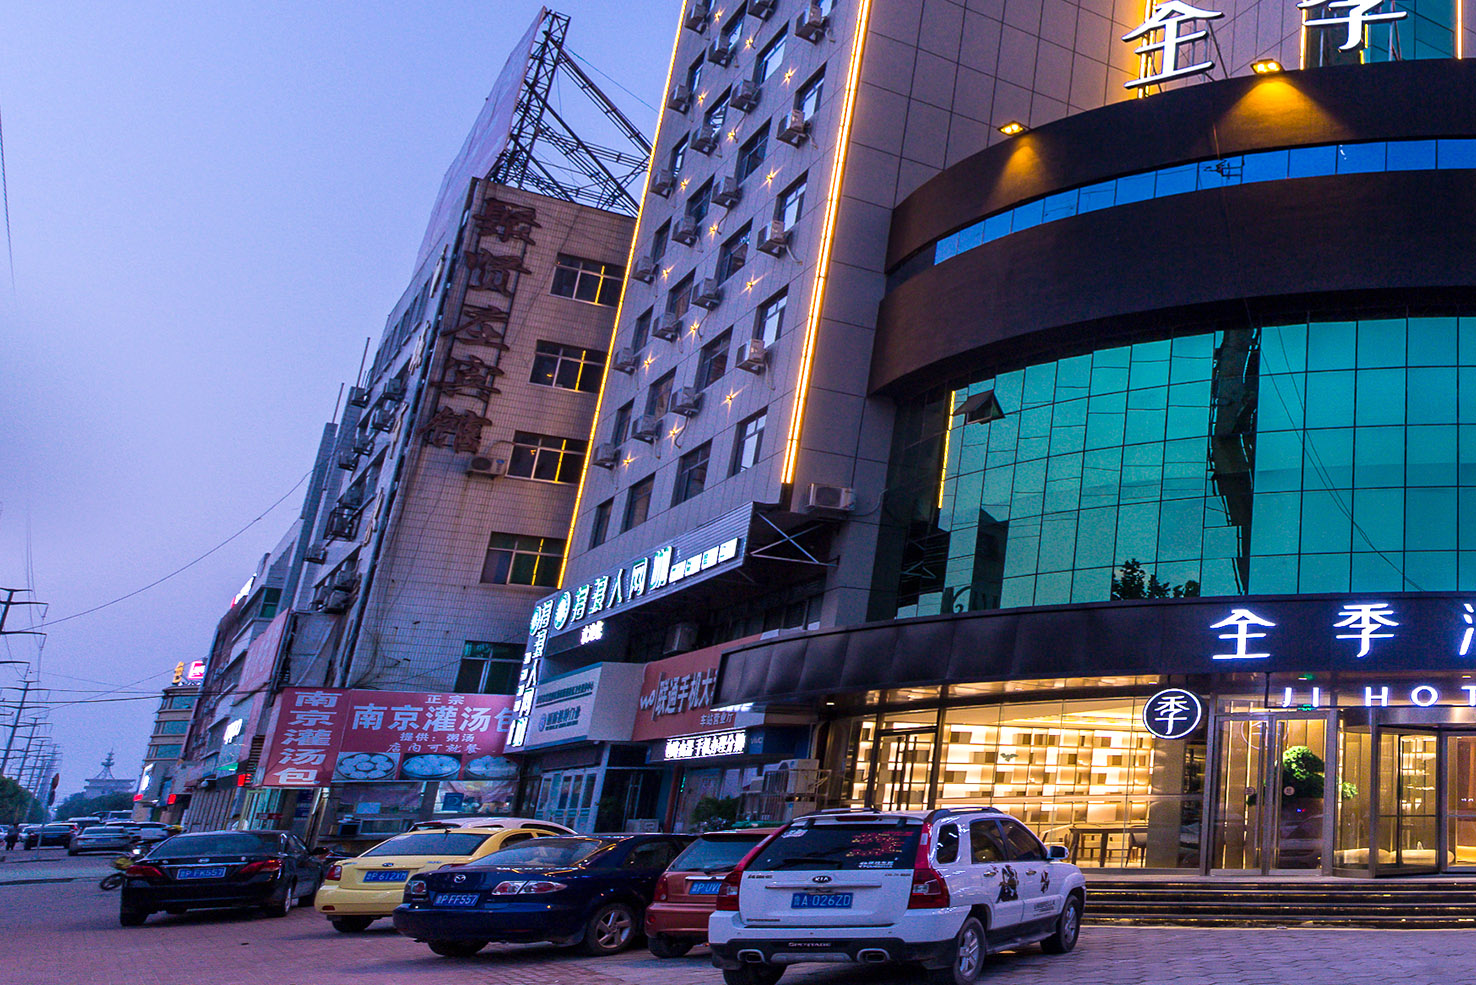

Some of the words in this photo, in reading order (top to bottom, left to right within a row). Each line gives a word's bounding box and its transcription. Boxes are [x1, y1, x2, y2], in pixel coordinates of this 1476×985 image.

[425, 694, 465, 706] 正宗
[1283, 685, 1320, 708] JI
[700, 711, 734, 726] 车站营业厅
[1153, 695, 1190, 735] 季
[272, 691, 343, 785] 南京灌汤包
[386, 743, 482, 754] 店内可就餐
